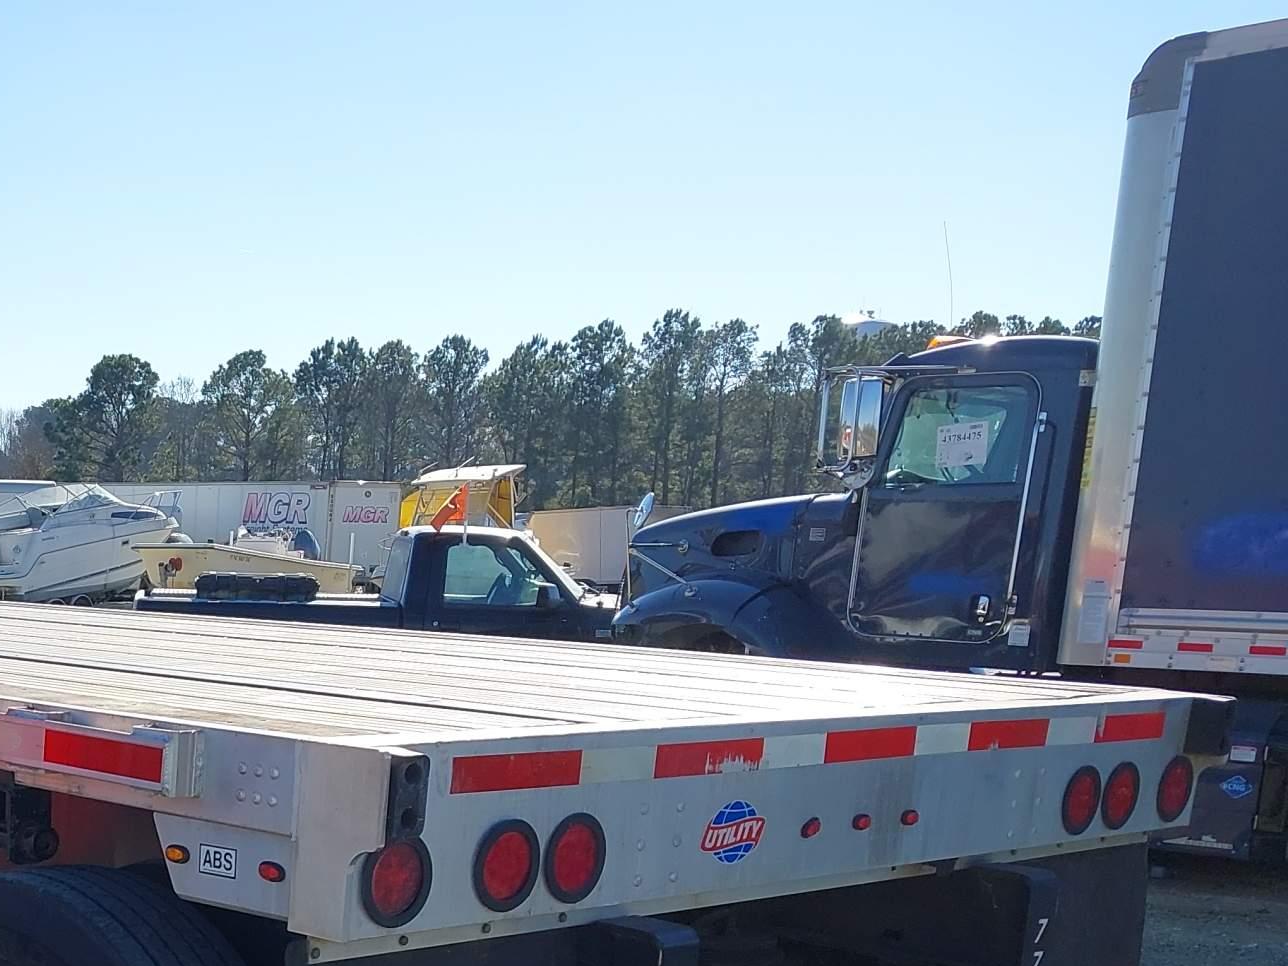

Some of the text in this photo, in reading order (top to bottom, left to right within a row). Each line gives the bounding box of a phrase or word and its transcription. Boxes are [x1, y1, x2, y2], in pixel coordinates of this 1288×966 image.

[242, 492, 311, 524] MGR
[342, 505, 389, 523] MGR
[704, 820, 763, 849] UTILITY
[203, 850, 233, 871] ABS
